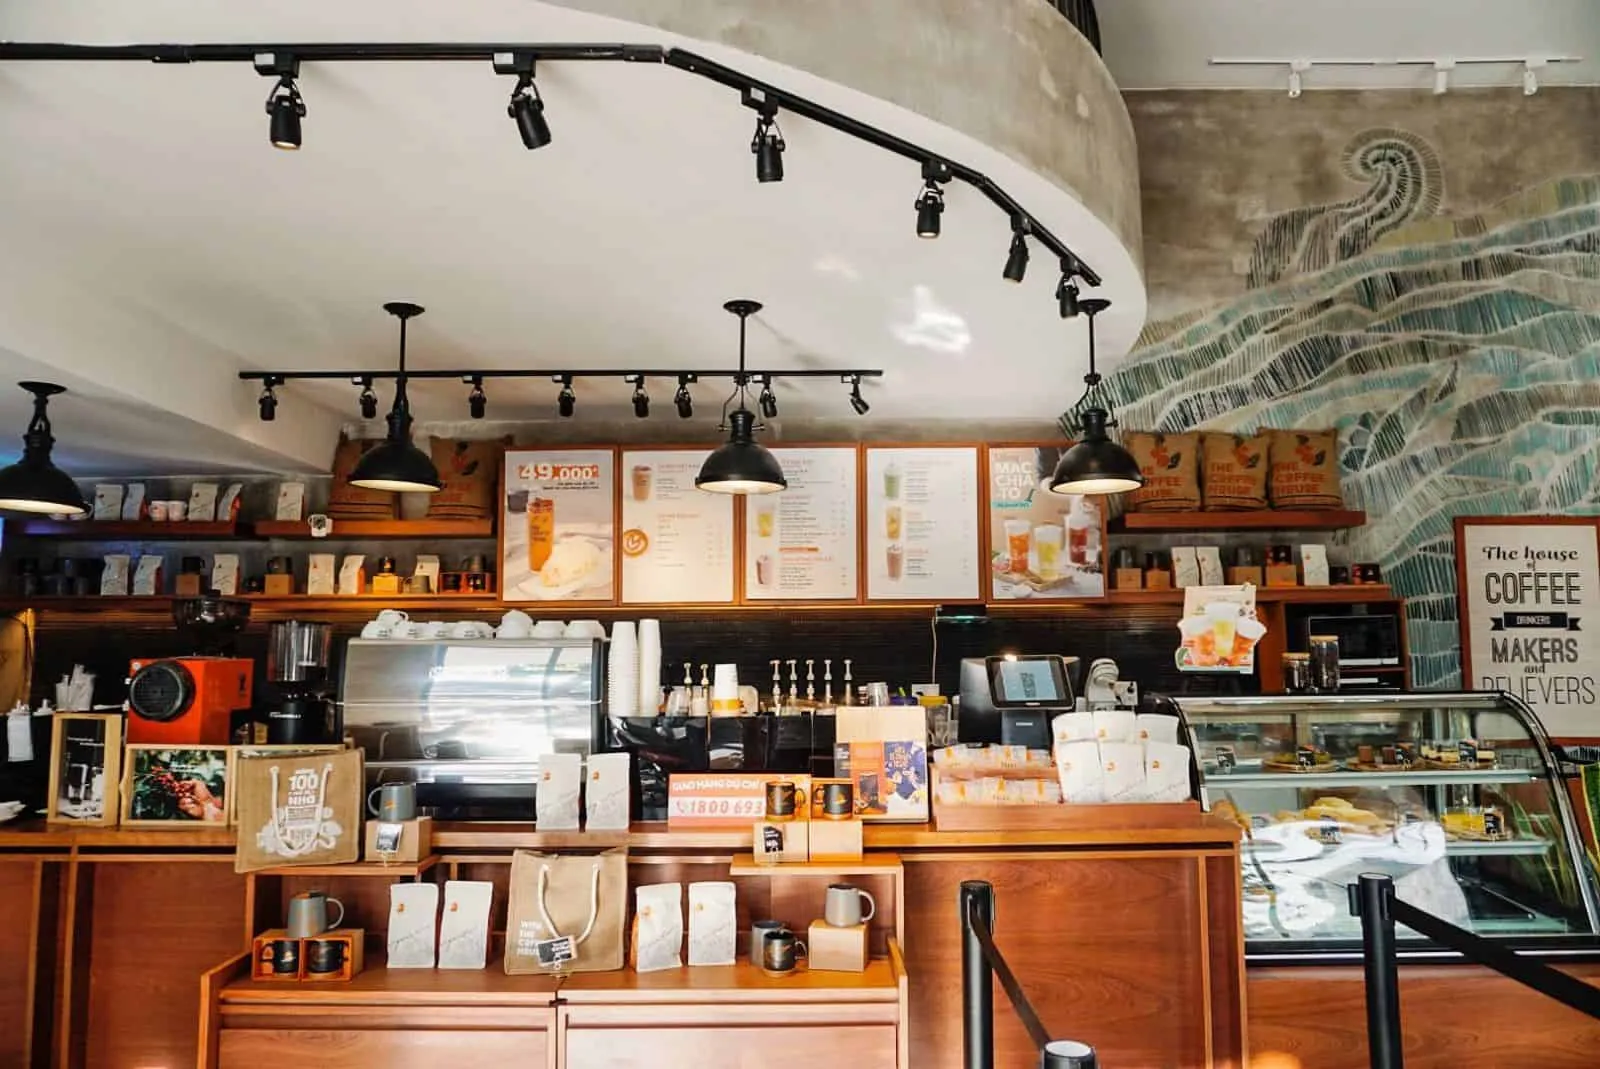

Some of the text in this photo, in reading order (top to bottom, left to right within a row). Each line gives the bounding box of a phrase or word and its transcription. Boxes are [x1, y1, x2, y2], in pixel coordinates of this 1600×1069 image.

[994, 461, 1032, 474] MAC
[1211, 463, 1233, 472] THE
[995, 474, 1035, 487] CHIA
[1274, 473, 1325, 483] COFFEE
[1482, 546, 1579, 562] The house
[1485, 572, 1582, 605] COFFEE
[1491, 637, 1579, 664] MAKERS
[1524, 661, 1546, 674] and
[690, 800, 729, 814] 1800
